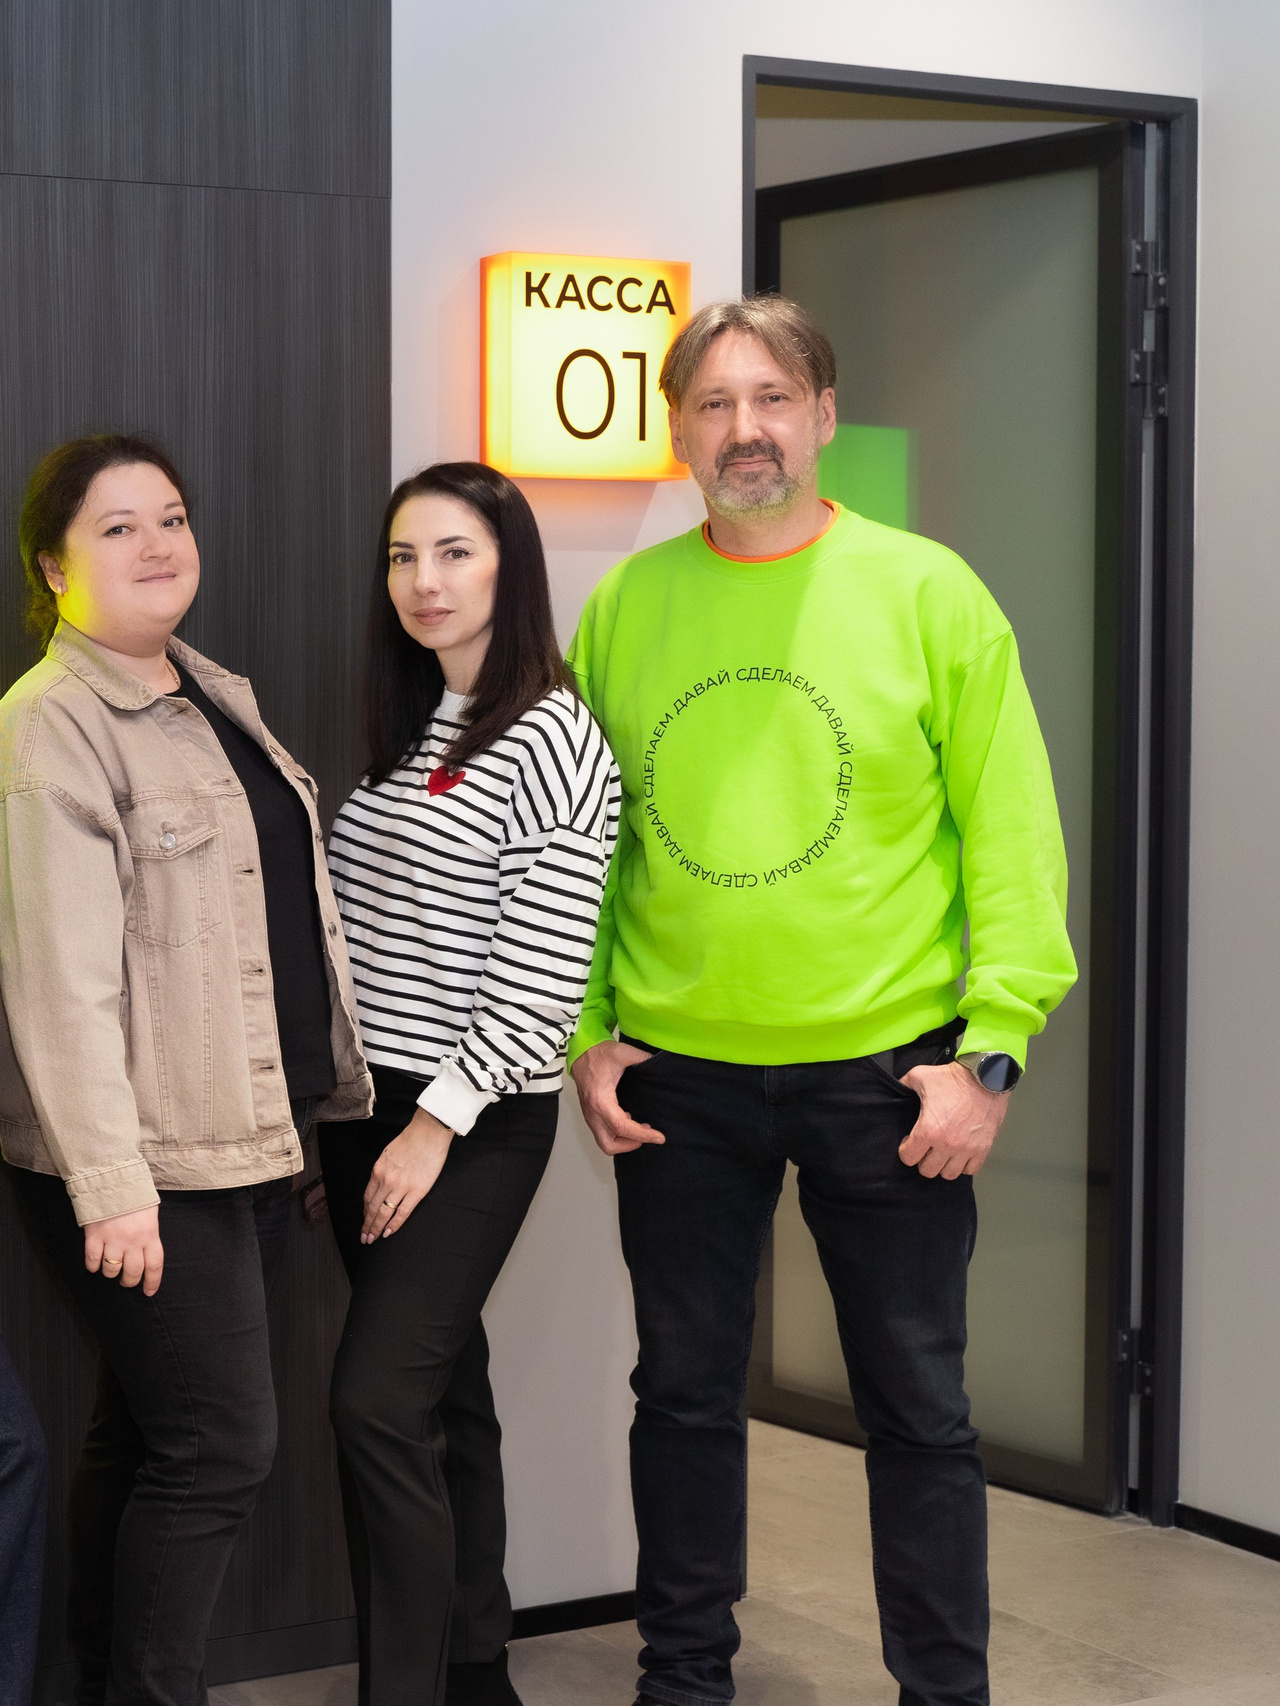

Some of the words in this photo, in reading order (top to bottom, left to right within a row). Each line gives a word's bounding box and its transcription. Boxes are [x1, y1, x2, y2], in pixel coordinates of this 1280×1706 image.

[524, 271, 676, 315] КАССА
[556, 348, 646, 441] 01
[673, 669, 730, 715] ДАВАЙ
[736, 667, 816, 696] СДЕЛАЕМ
[811, 695, 854, 755] ДАВАЙ
[644, 713, 674, 798] СДЕЛАЕМ
[645, 803, 682, 858] ДАВАЙ
[679, 855, 758, 888] СДЕЛАЕМ
